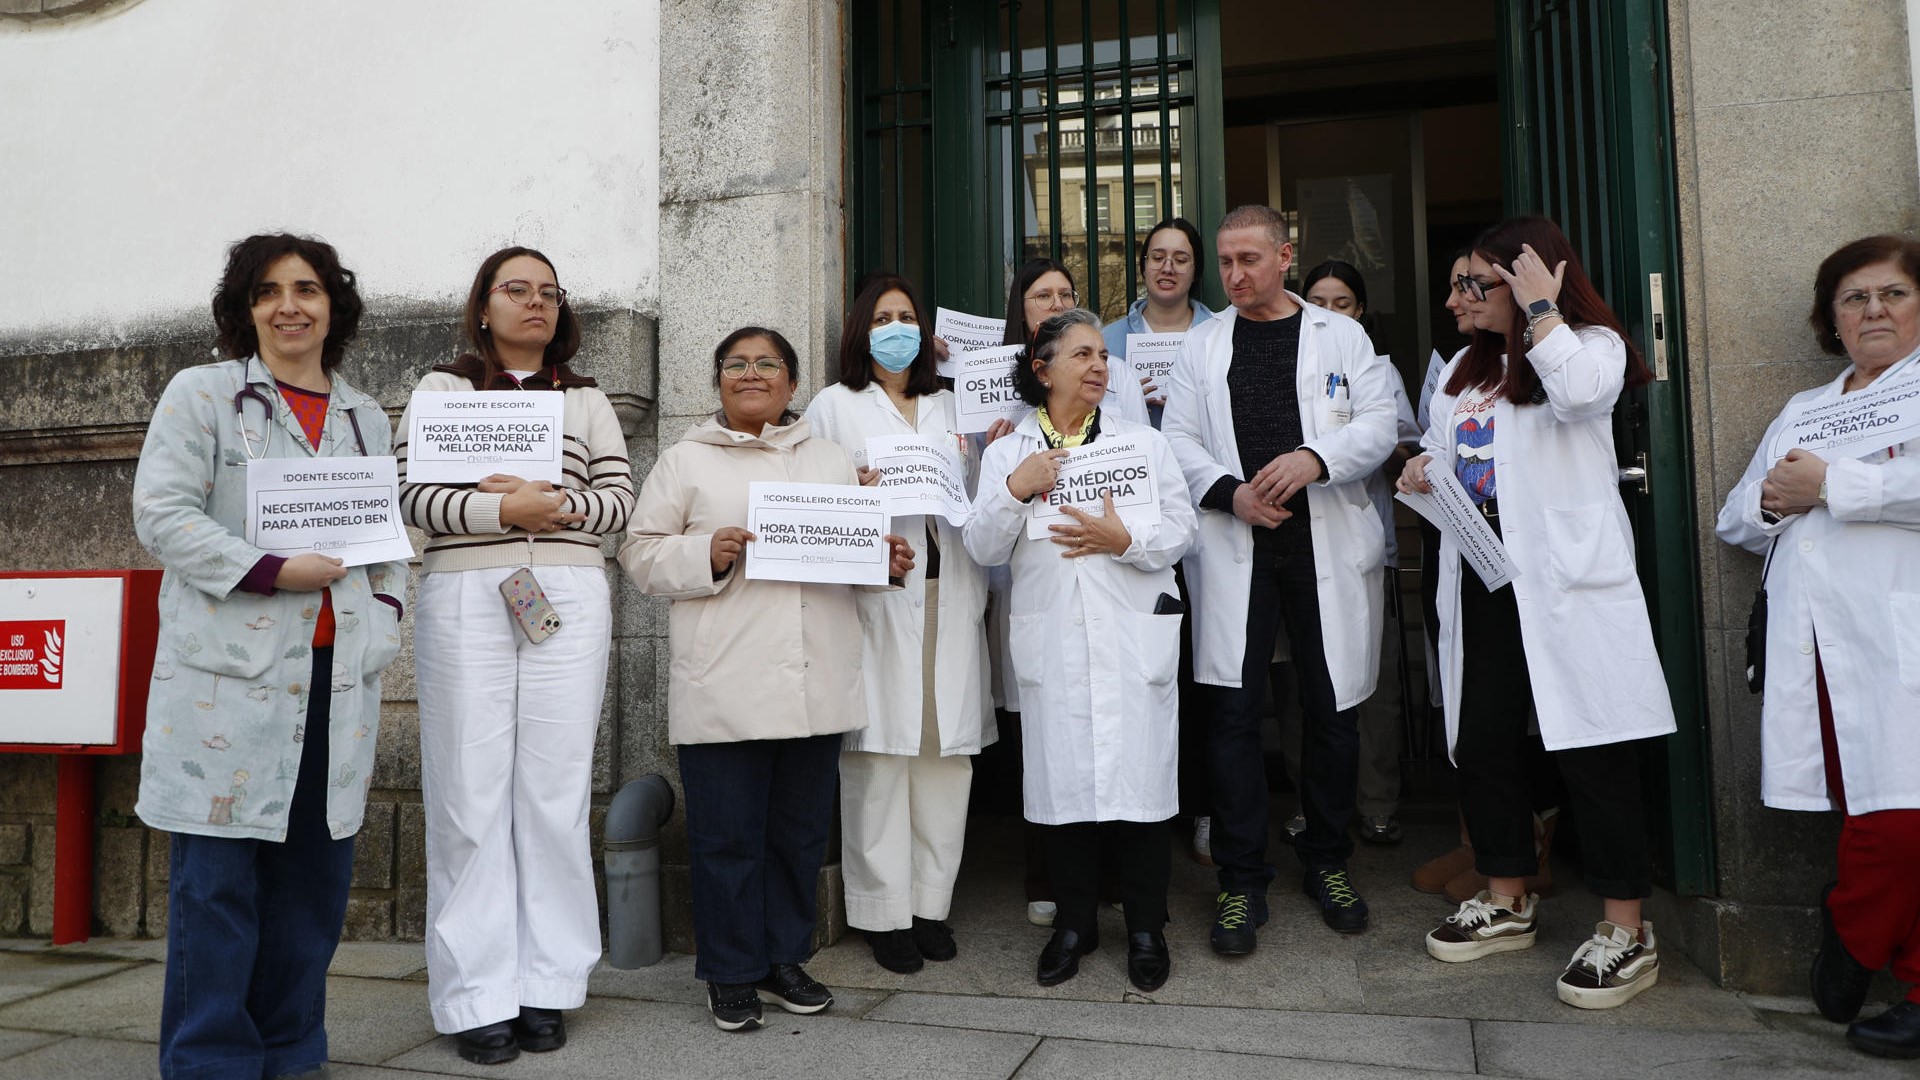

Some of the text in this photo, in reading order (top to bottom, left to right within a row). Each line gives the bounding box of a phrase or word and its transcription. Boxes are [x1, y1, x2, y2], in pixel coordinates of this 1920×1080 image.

[942, 333, 985, 347] XORNADA
[1149, 369, 1155, 377] E
[965, 378, 986, 392] OS
[980, 391, 1000, 404] EN
[1849, 390, 1919, 413] CANSADO
[1821, 410, 1878, 430] DOENTE
[422, 423, 550, 433] HOXE IMOS A FOLGA
[1798, 414, 1899, 444] MAL-TRATADO
[425, 433, 546, 443] PARA ATENDERLLE
[438, 443, 491, 453] MELLOR
[1090, 444, 1135, 458] ESCUCHA!!
[331, 472, 374, 481] ESCOITA!
[880, 465, 904, 476] NON
[906, 464, 938, 475] QUERE
[880, 476, 923, 487] ATENDA
[925, 476, 939, 487] NA
[1056, 466, 1148, 491] S MÉDICOS
[1049, 483, 1135, 506] EN LUCHA
[262, 498, 389, 514] NECESITAMOS TEMPO
[836, 497, 881, 507] ESCOITA!!
[262, 514, 388, 531] PARA ATENDELO BEN
[760, 523, 880, 537] HORA TRABALLADA
[764, 534, 874, 548] HORA COMPUTADA
[11, 635, 24, 646] USO
[0, 649, 34, 661] EXCLUSIVO
[3, 664, 38, 676] BOMBEROS
